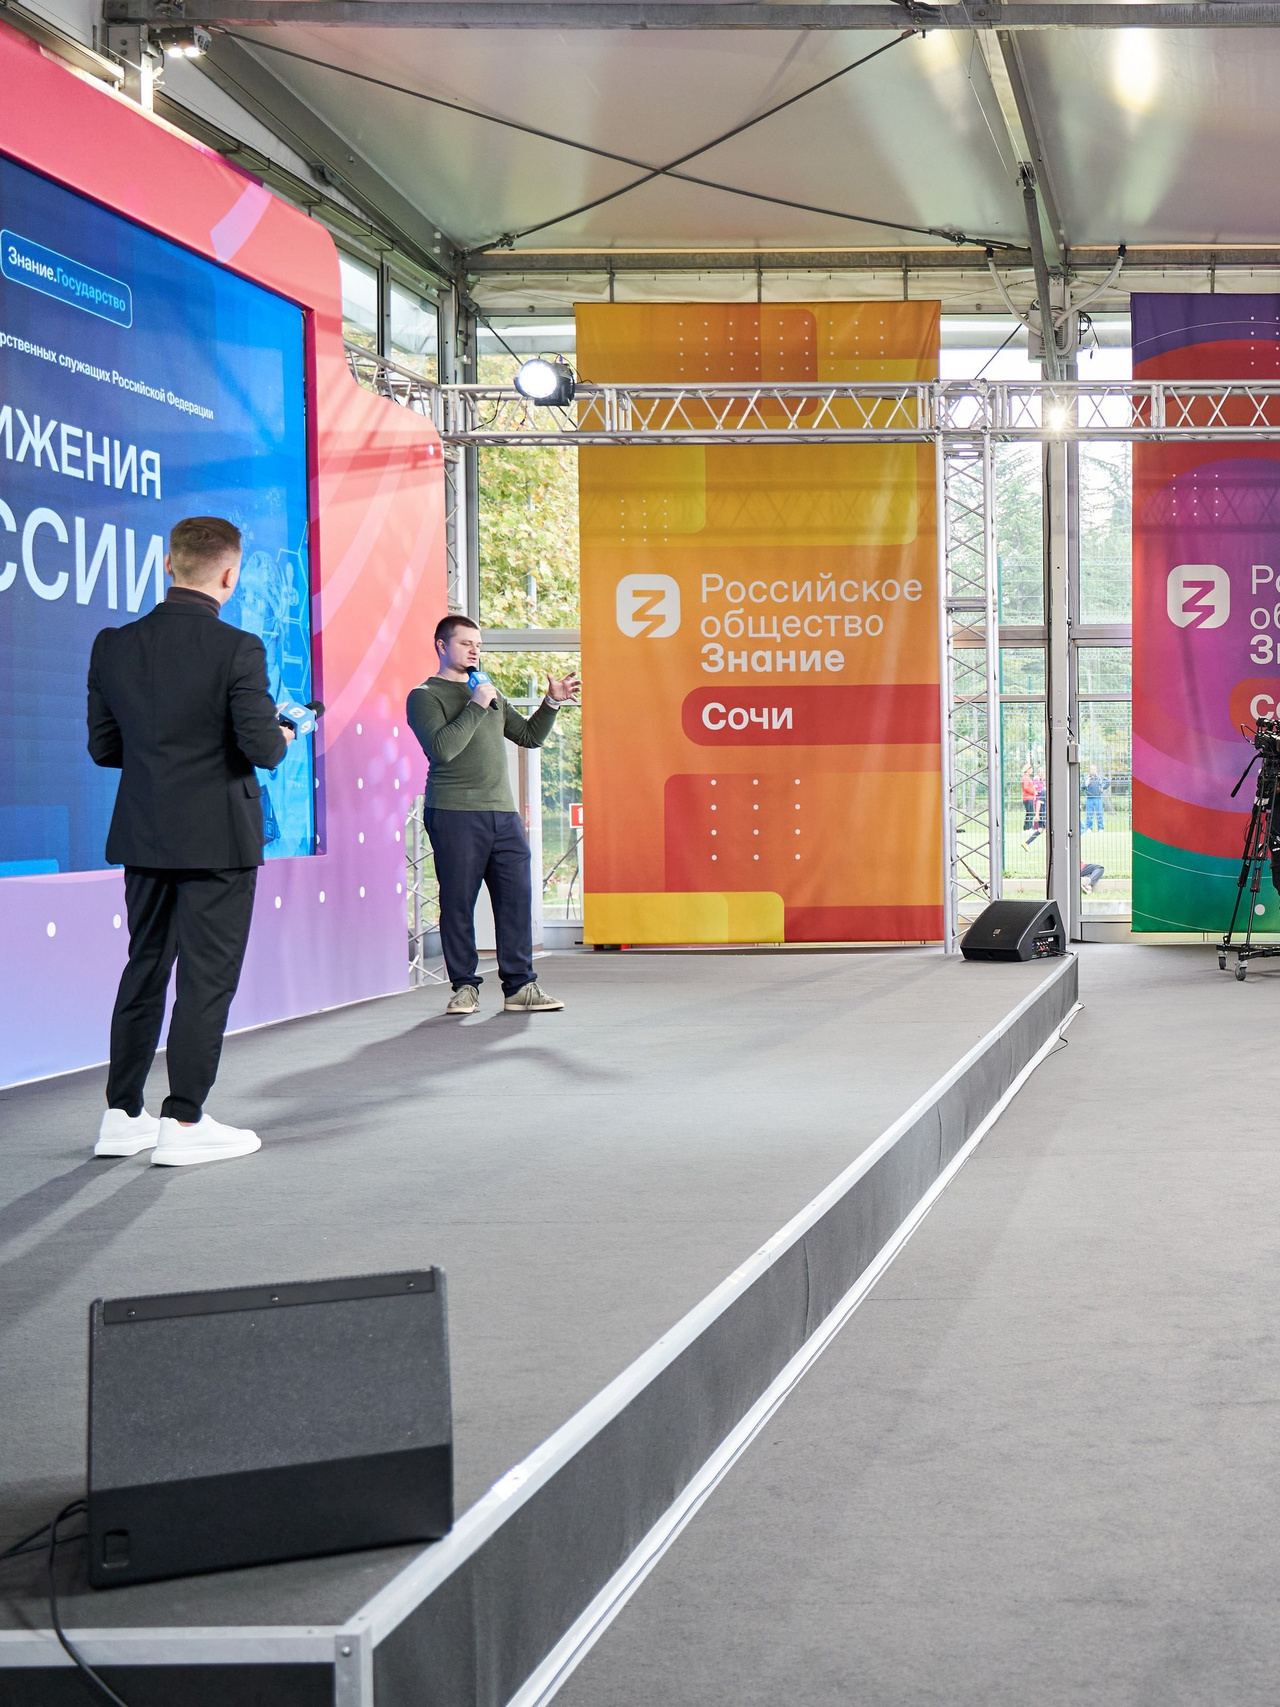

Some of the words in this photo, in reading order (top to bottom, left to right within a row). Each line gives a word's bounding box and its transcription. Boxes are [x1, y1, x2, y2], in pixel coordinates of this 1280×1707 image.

[8, 246, 126, 312] Знание.Государство
[58, 353, 111, 383] служащих
[112, 370, 166, 402] Российской
[166, 391, 214, 420] Федерации
[701, 573, 923, 603] Российское
[700, 608, 884, 642] общество
[700, 642, 845, 673] Знание
[701, 702, 793, 730] Сочи
